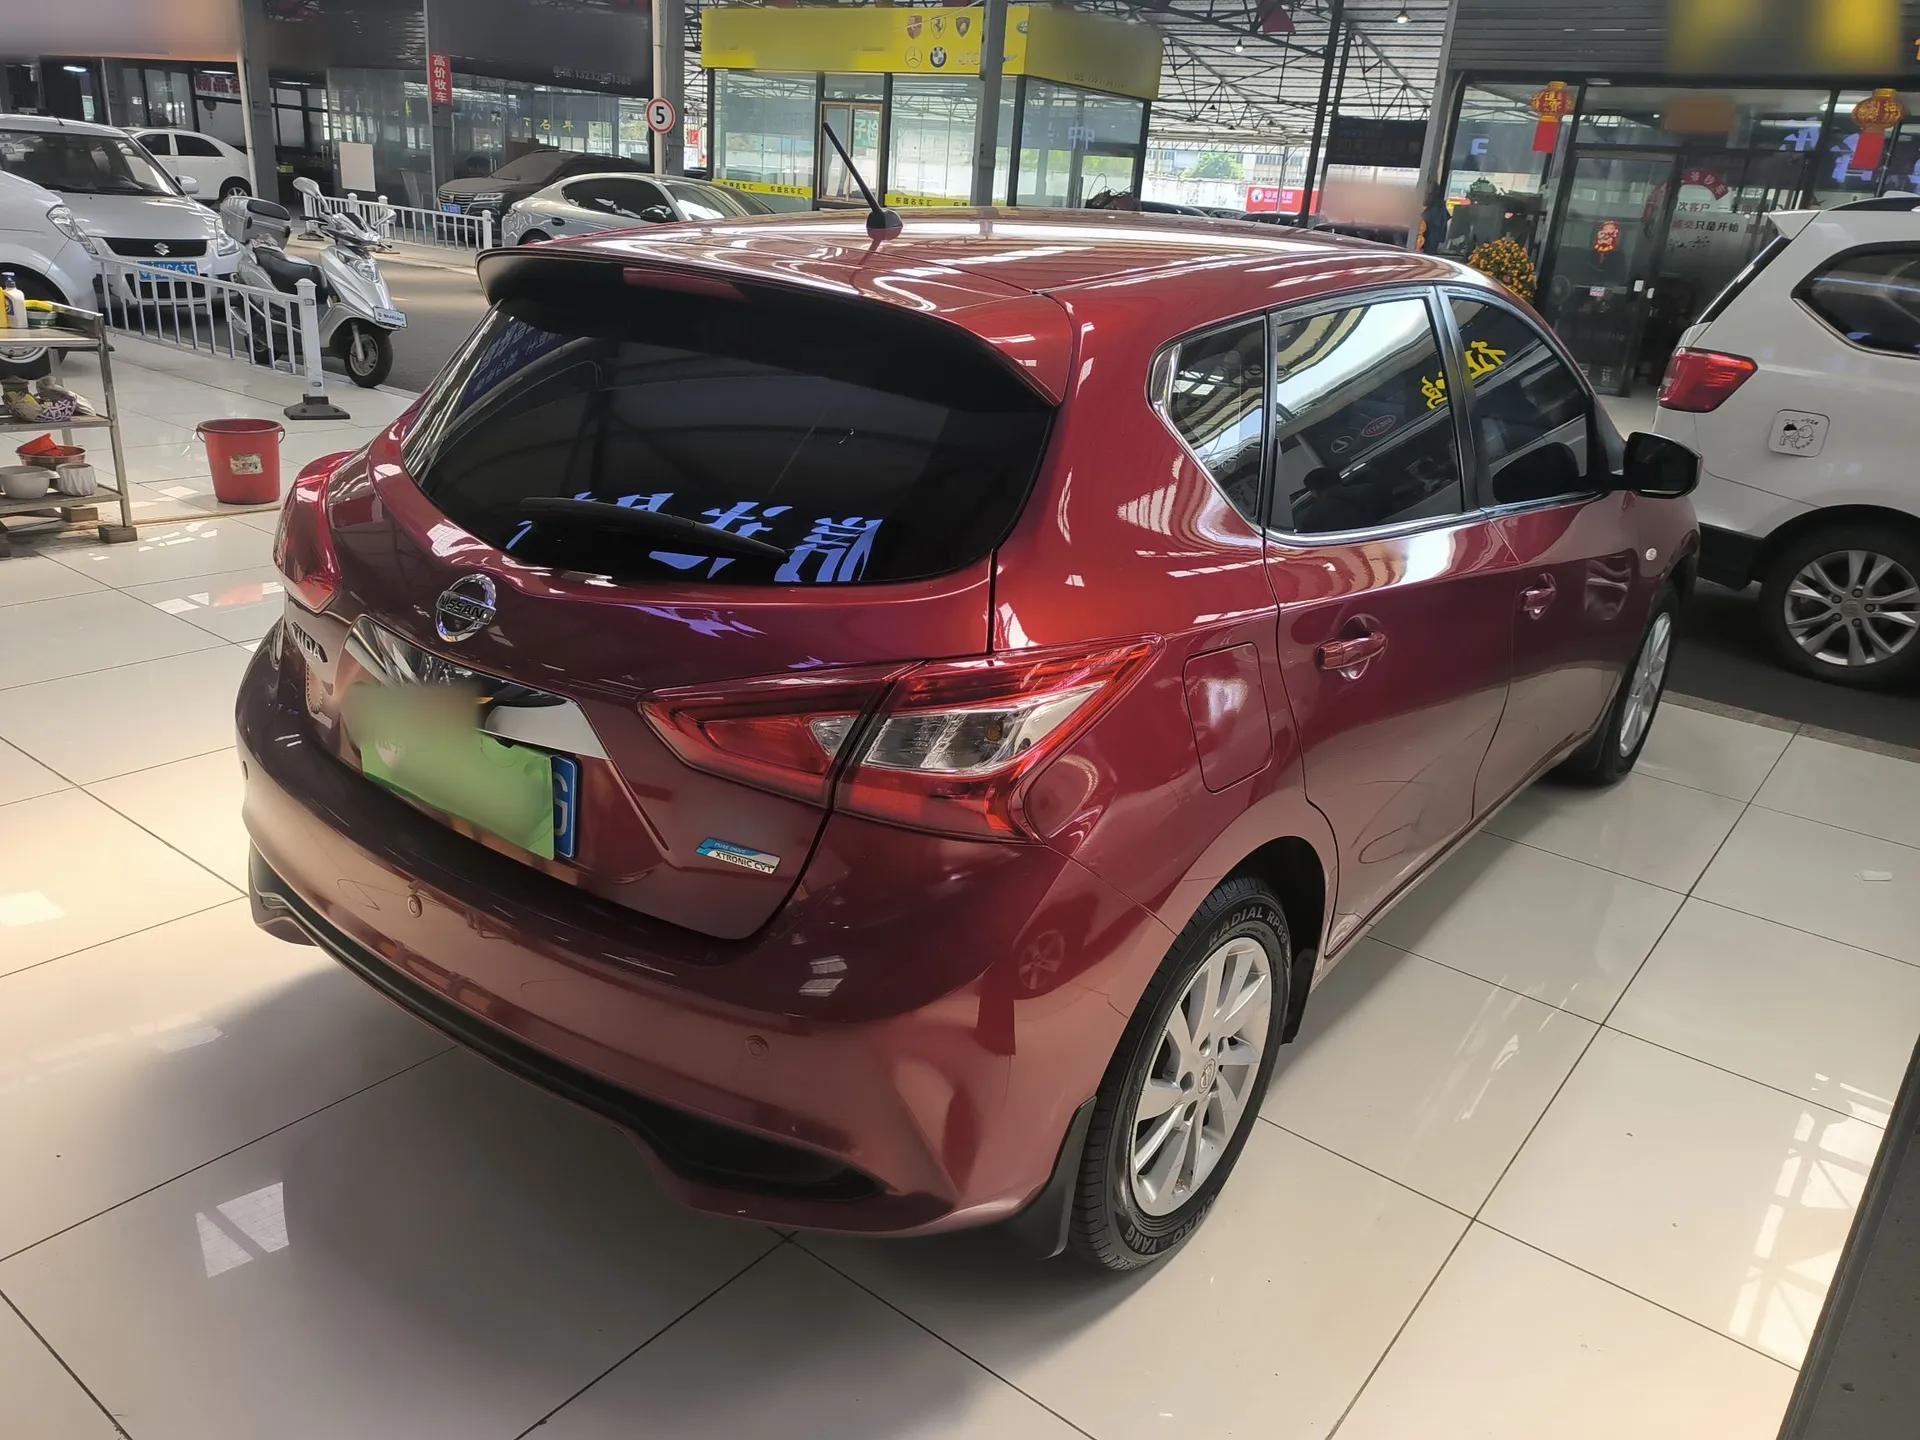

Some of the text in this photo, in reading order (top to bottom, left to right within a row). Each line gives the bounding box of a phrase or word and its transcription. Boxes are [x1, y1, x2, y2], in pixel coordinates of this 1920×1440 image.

[431, 54, 448, 103] 高价收车
[655, 105, 666, 125] 5
[439, 592, 485, 620] NISSAN
[715, 851, 774, 872] XTRONIC CVT
[1208, 906, 1263, 947] RADIAL
[1124, 1224, 1158, 1254] YANG
